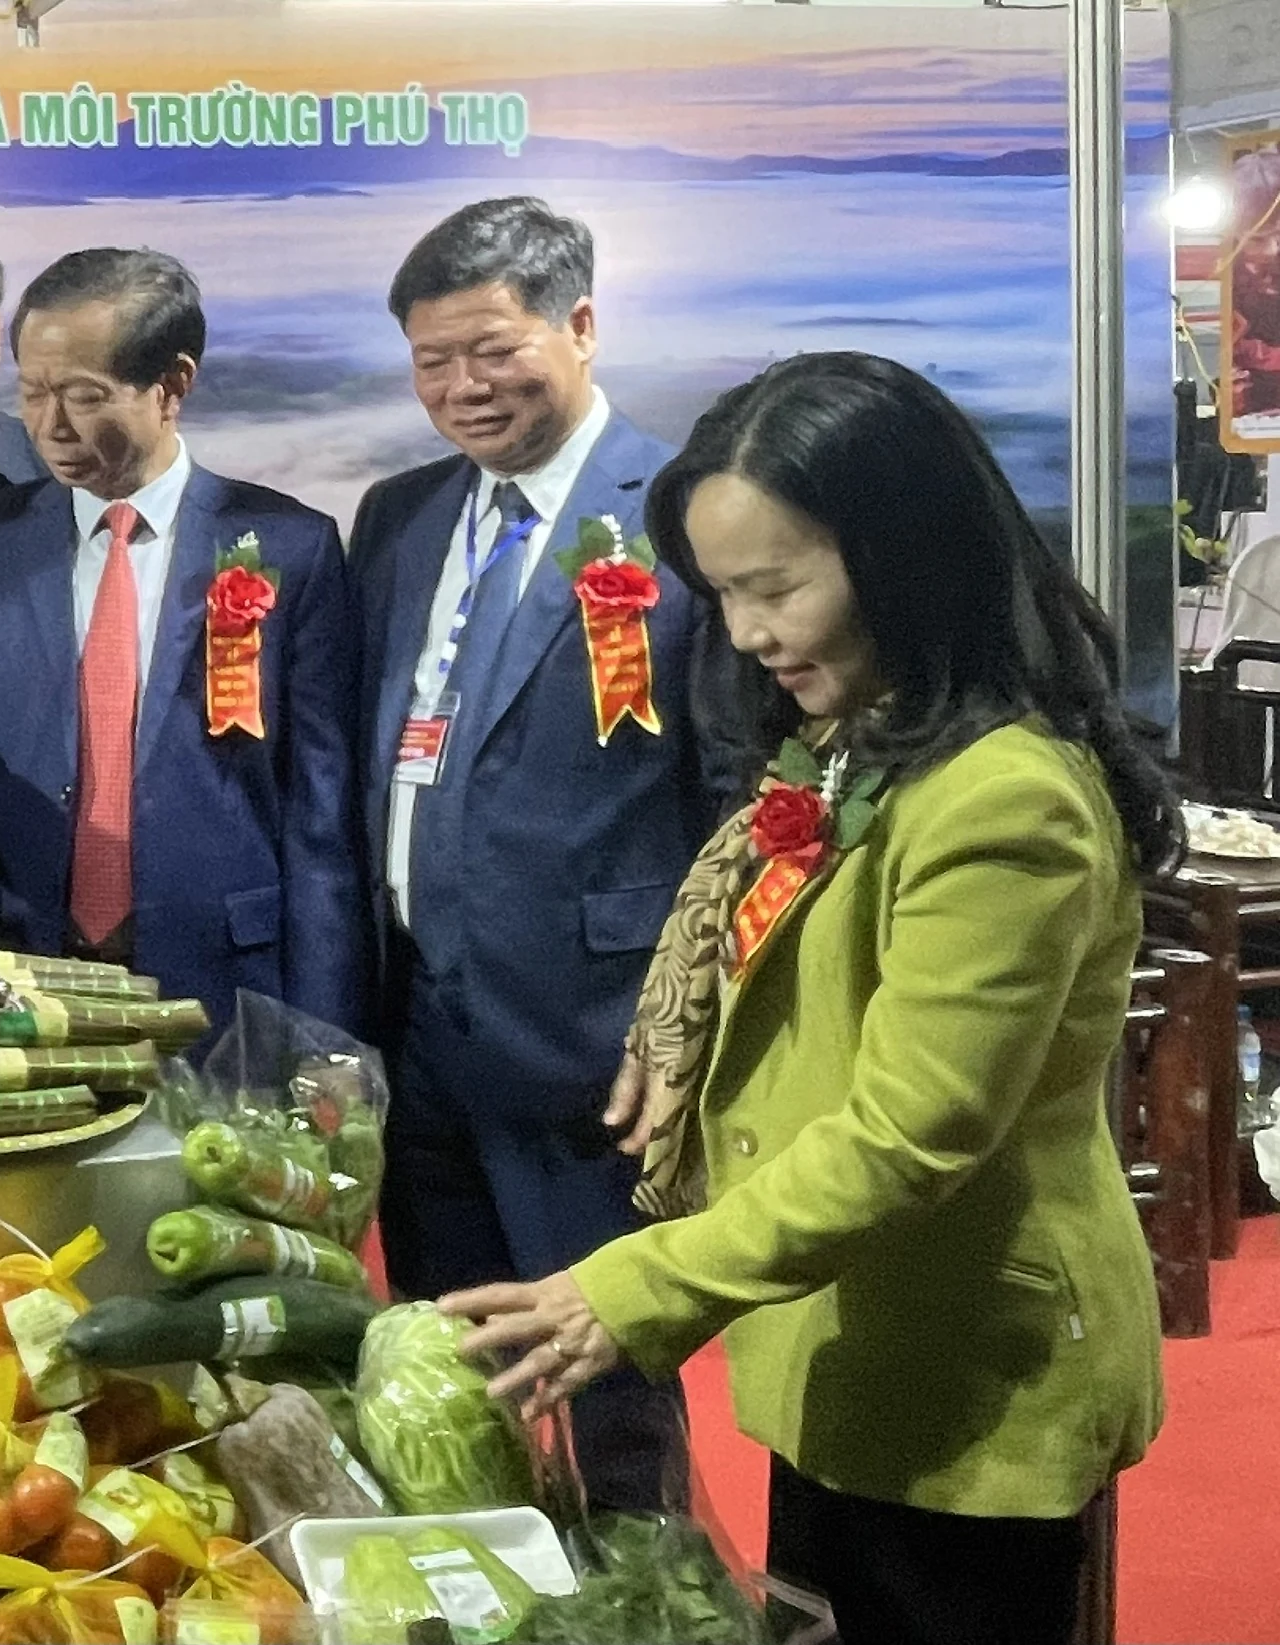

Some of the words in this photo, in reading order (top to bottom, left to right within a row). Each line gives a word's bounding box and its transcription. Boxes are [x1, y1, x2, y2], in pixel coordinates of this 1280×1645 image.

[21, 83, 117, 147] MÔI
[129, 82, 320, 147] TRƯỜNG
[334, 83, 427, 145] PHÚ
[439, 93, 526, 156] THỌ
